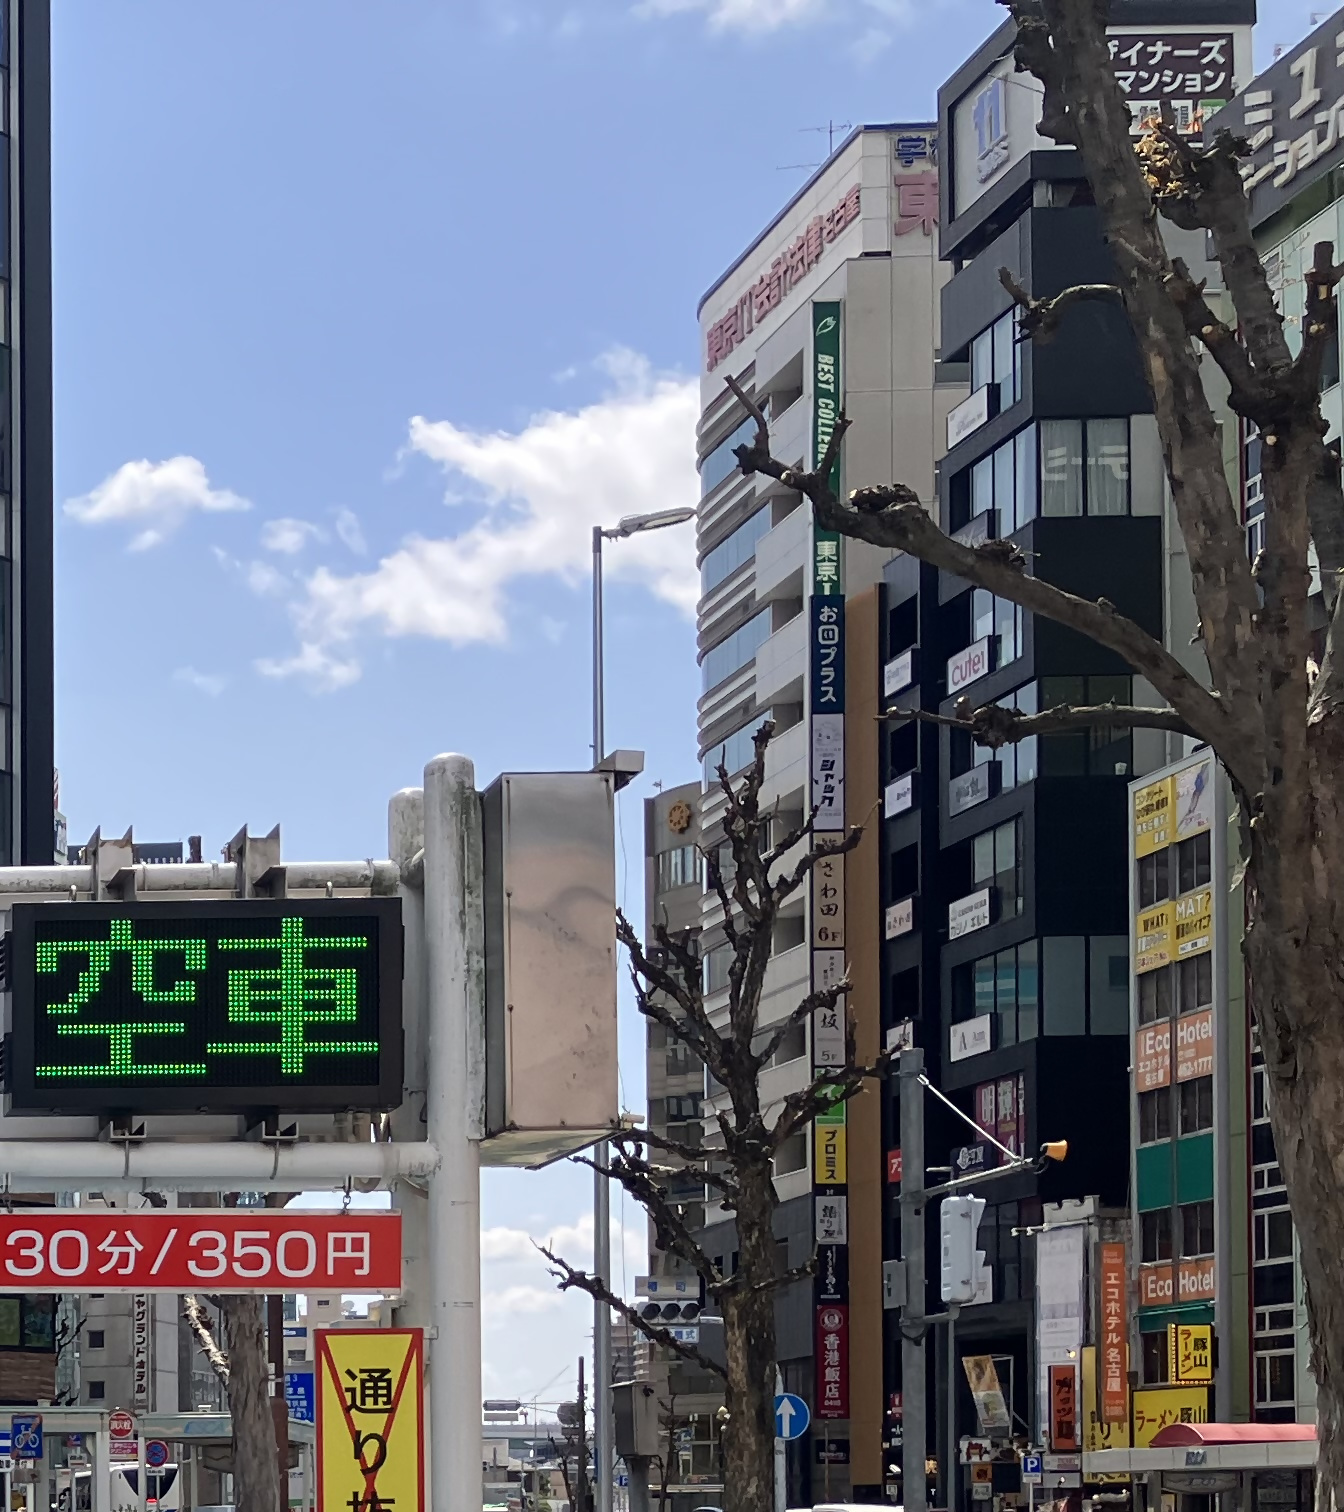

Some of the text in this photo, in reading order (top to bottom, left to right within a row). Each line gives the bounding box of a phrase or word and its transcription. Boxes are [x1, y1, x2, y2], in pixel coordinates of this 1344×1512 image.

[1114, 70, 1226, 94] マンション
[817, 353, 835, 393] BEST
[1176, 891, 1211, 921] MAT?
[818, 927, 841, 942] 6F
[34, 915, 380, 1078] 空車
[1145, 1031, 1170, 1055] Eco
[1177, 1014, 1212, 1047] Hotel
[824, 1129, 838, 1180] プロミス
[5, 1228, 371, 1277] 30分/350円
[1147, 1267, 1214, 1298] Eco Hotel
[824, 1333, 841, 1399] 香港飯店
[1179, 1329, 1194, 1375] ラーメン
[1026, 1458, 1038, 1473] P
